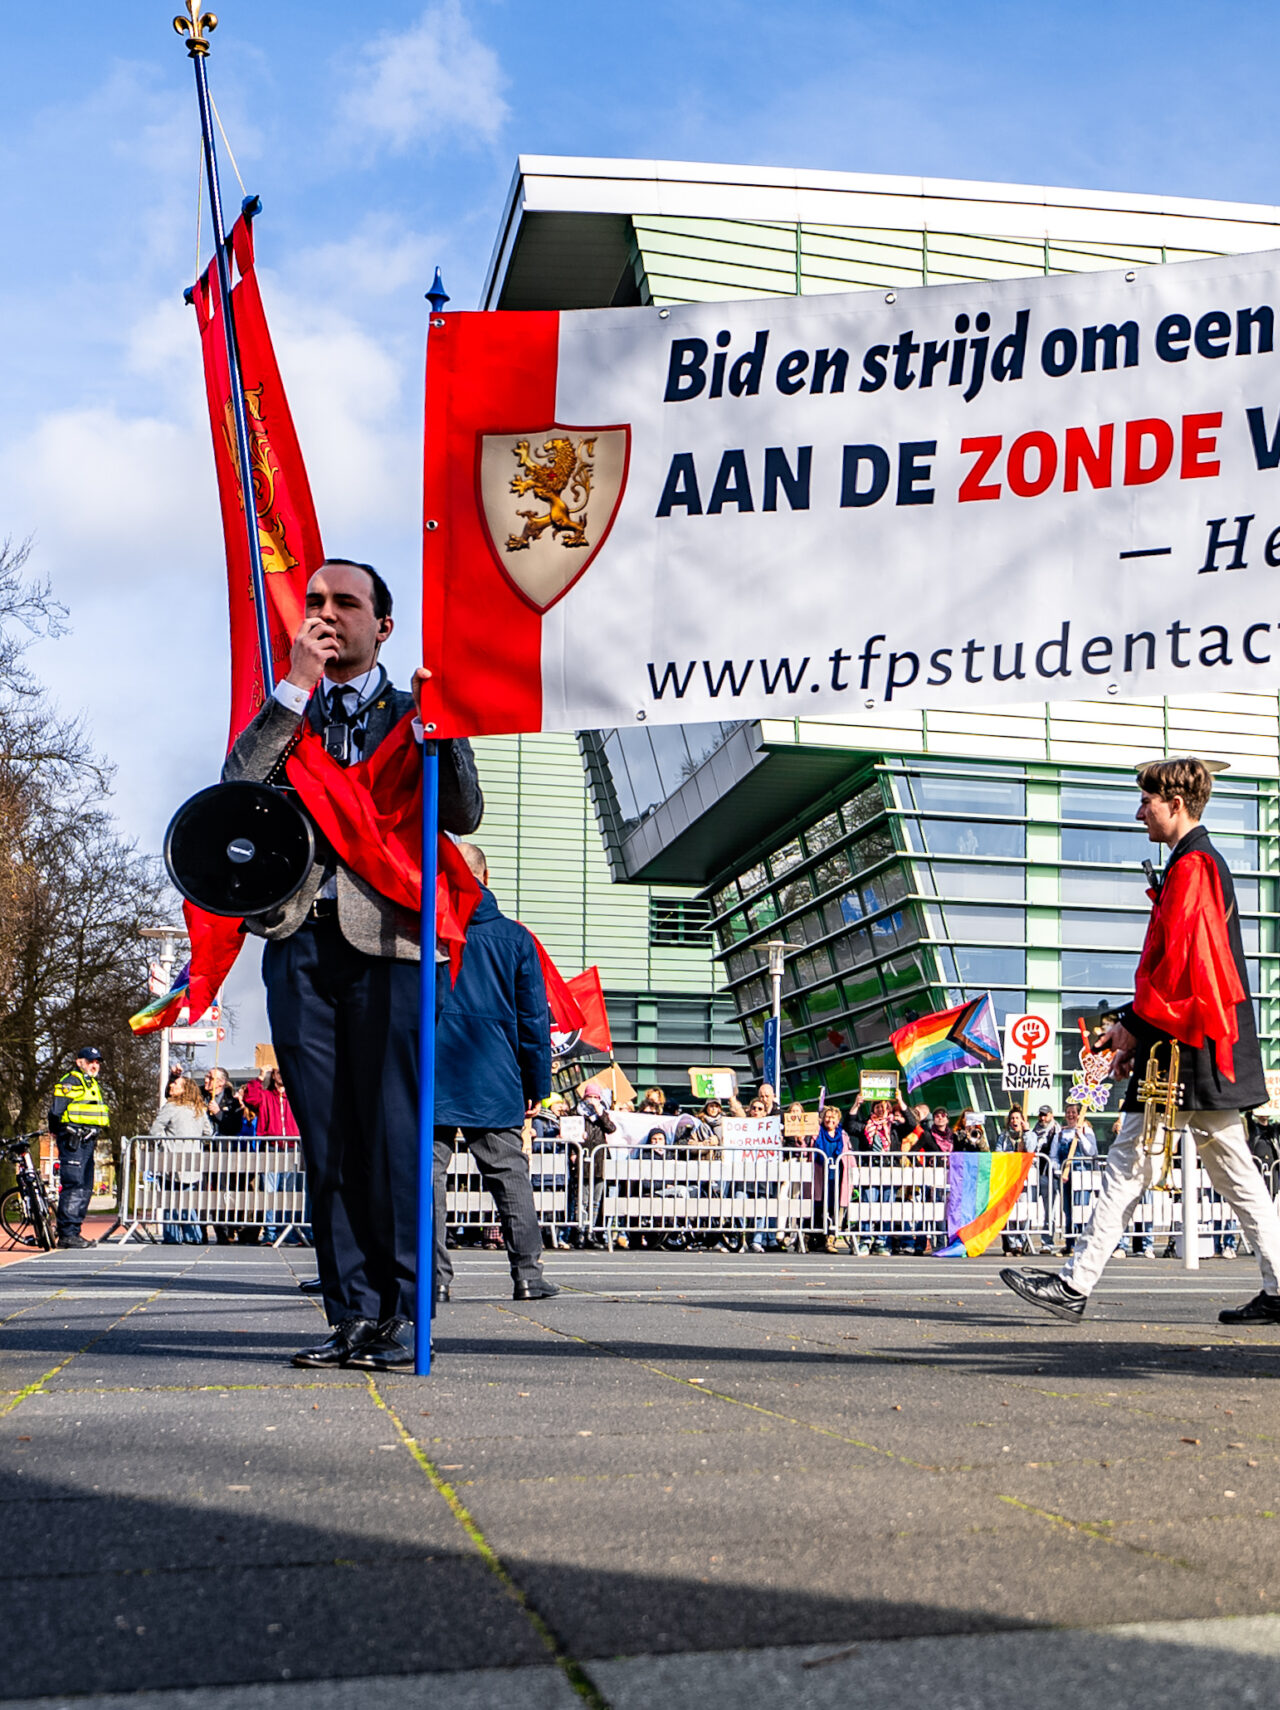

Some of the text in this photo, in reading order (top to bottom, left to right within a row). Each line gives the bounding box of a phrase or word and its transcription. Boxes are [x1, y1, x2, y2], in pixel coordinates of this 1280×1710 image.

[664, 330, 769, 403] Bid
[776, 347, 849, 396] en
[859, 309, 1031, 403] strijd
[1041, 320, 1140, 378] om
[1155, 306, 1275, 363] een
[655, 446, 813, 518] AAN
[840, 440, 938, 508] DE
[958, 411, 1223, 503] ZONDE
